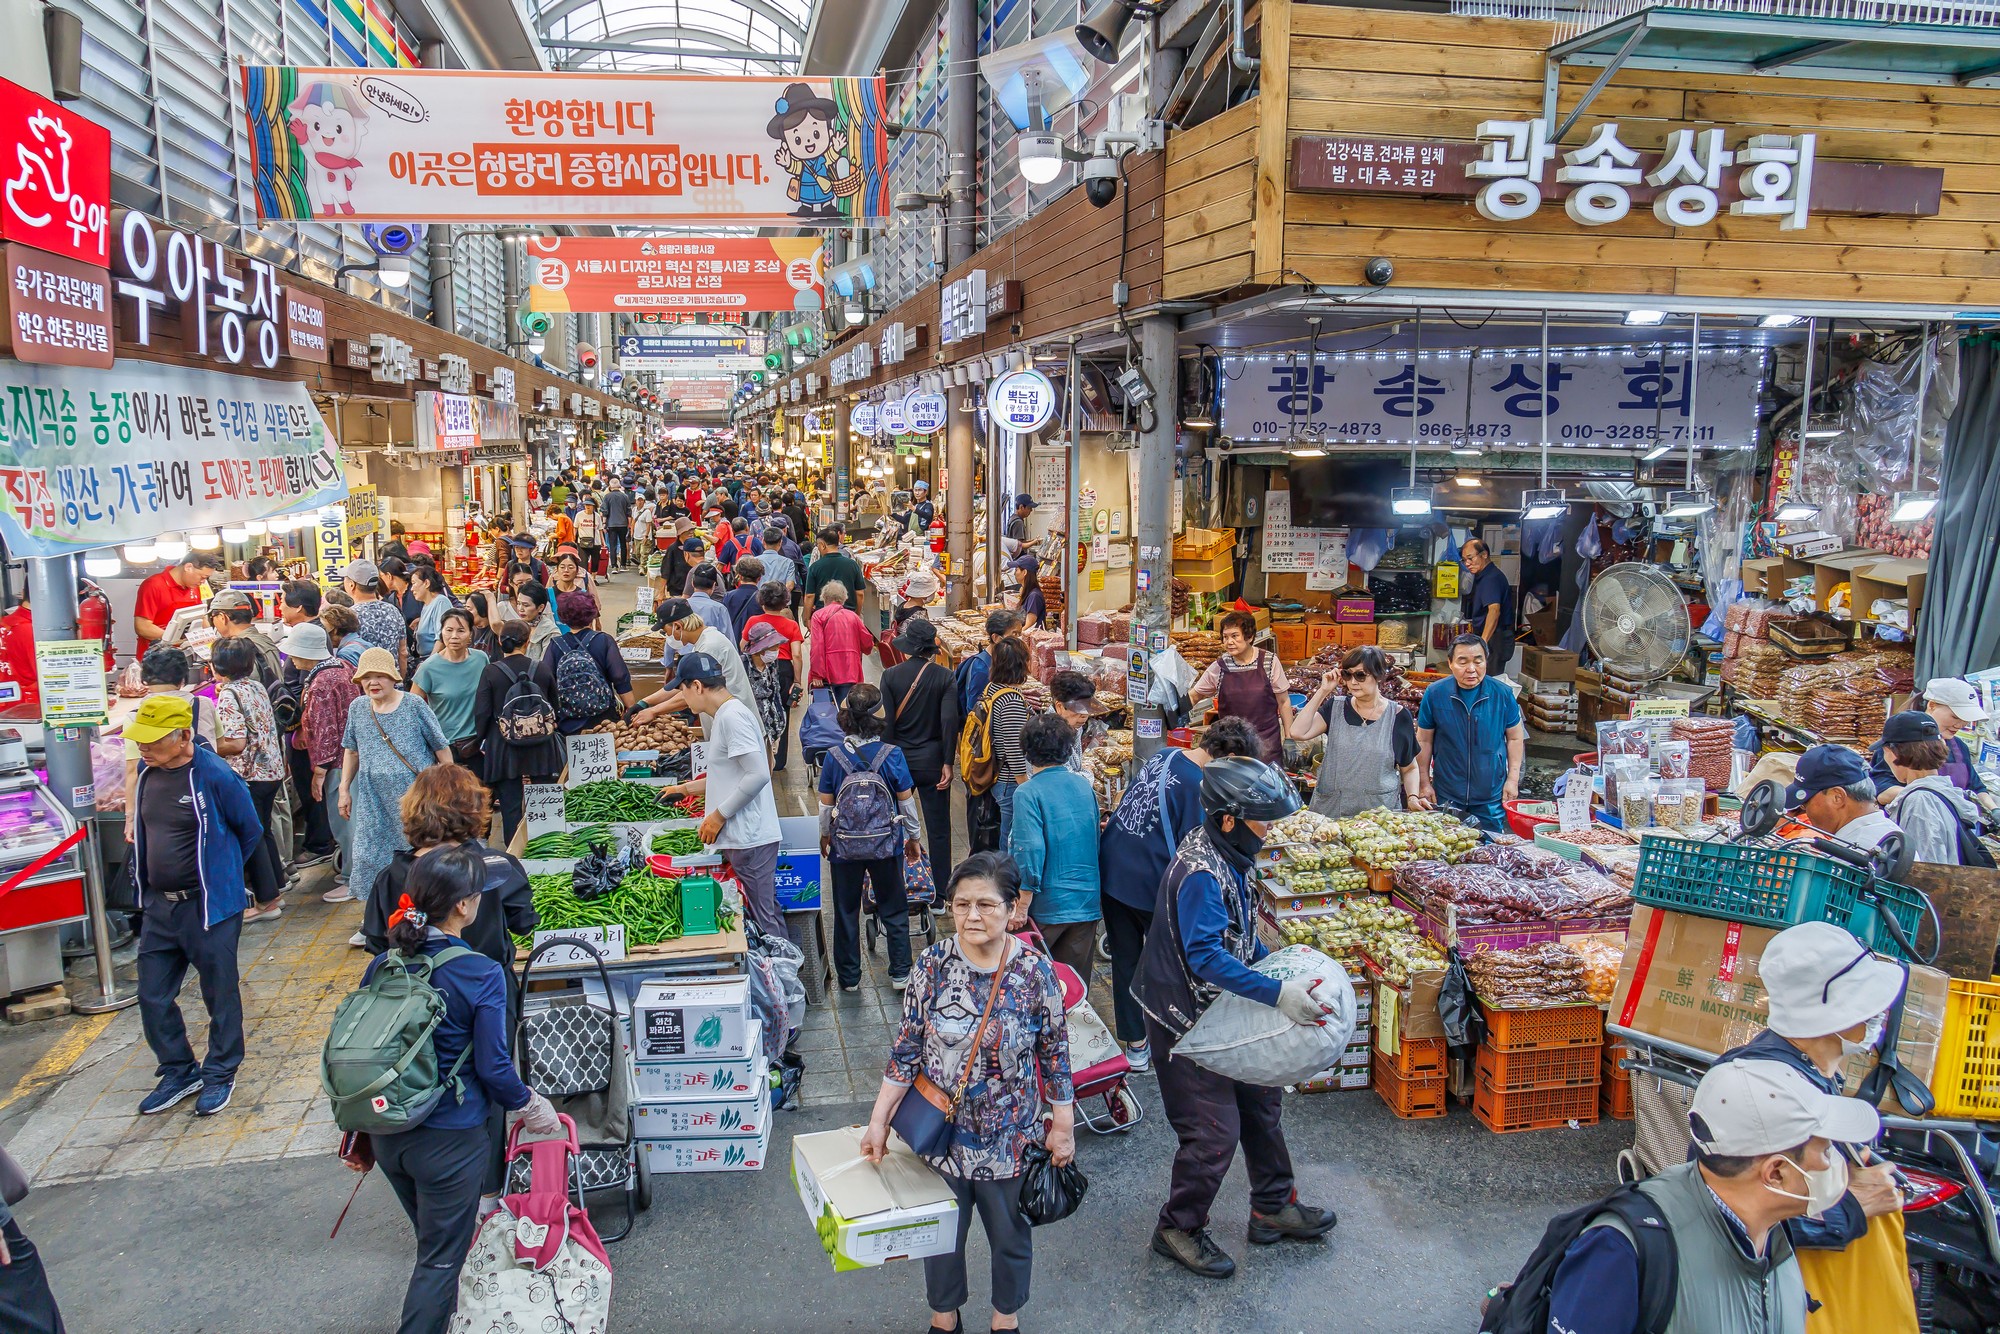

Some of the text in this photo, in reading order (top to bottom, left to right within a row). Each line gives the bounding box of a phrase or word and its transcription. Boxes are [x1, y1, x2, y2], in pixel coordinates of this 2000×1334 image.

[366, 85, 414, 116] 안녕하세요!
[505, 98, 655, 137] 환영합니다
[1326, 142, 1444, 166] 건강식품.견과류 일체
[389, 151, 474, 187] 이곳은
[479, 150, 562, 187] 청량리
[1466, 119, 1816, 230] 광송상회
[65, 194, 109, 256] 우아
[541, 264, 563, 285] 경
[575, 260, 780, 274] 서울시 디자인 혁신 전통시장 조성
[791, 263, 812, 285] 축
[15, 265, 104, 312] 육가공전문업체
[118, 210, 281, 369] 우아농장
[637, 276, 722, 289] 공모사업 선정
[655, 296, 684, 304] 시장으로
[18, 311, 109, 352] 한우.한돈.부산물
[89, 391, 171, 446] 농장에서
[178, 395, 216, 441] 바로
[217, 397, 259, 442] 우리집
[263, 401, 312, 443] 식탁으로
[1419, 421, 1512, 438] 966-4873
[1560, 422, 1715, 441] 010-3285-7511
[0, 469, 56, 530] 직접
[201, 458, 258, 501] 도매가로
[258, 447, 341, 498] 판매합니다
[1340, 606, 1370, 614] Primavera
[1313, 628, 1336, 640] 대추
[581, 764, 612, 782] 3000
[1468, 926, 1502, 934] CALIFORNIA'S
[1658, 990, 1695, 1008] FRESH
[649, 1026, 682, 1034] 꽈리고추
[656, 1017, 672, 1026] 화천
[683, 1072, 710, 1085] 고추
[690, 1112, 717, 1125] 고추
[695, 1148, 721, 1161] 고추
